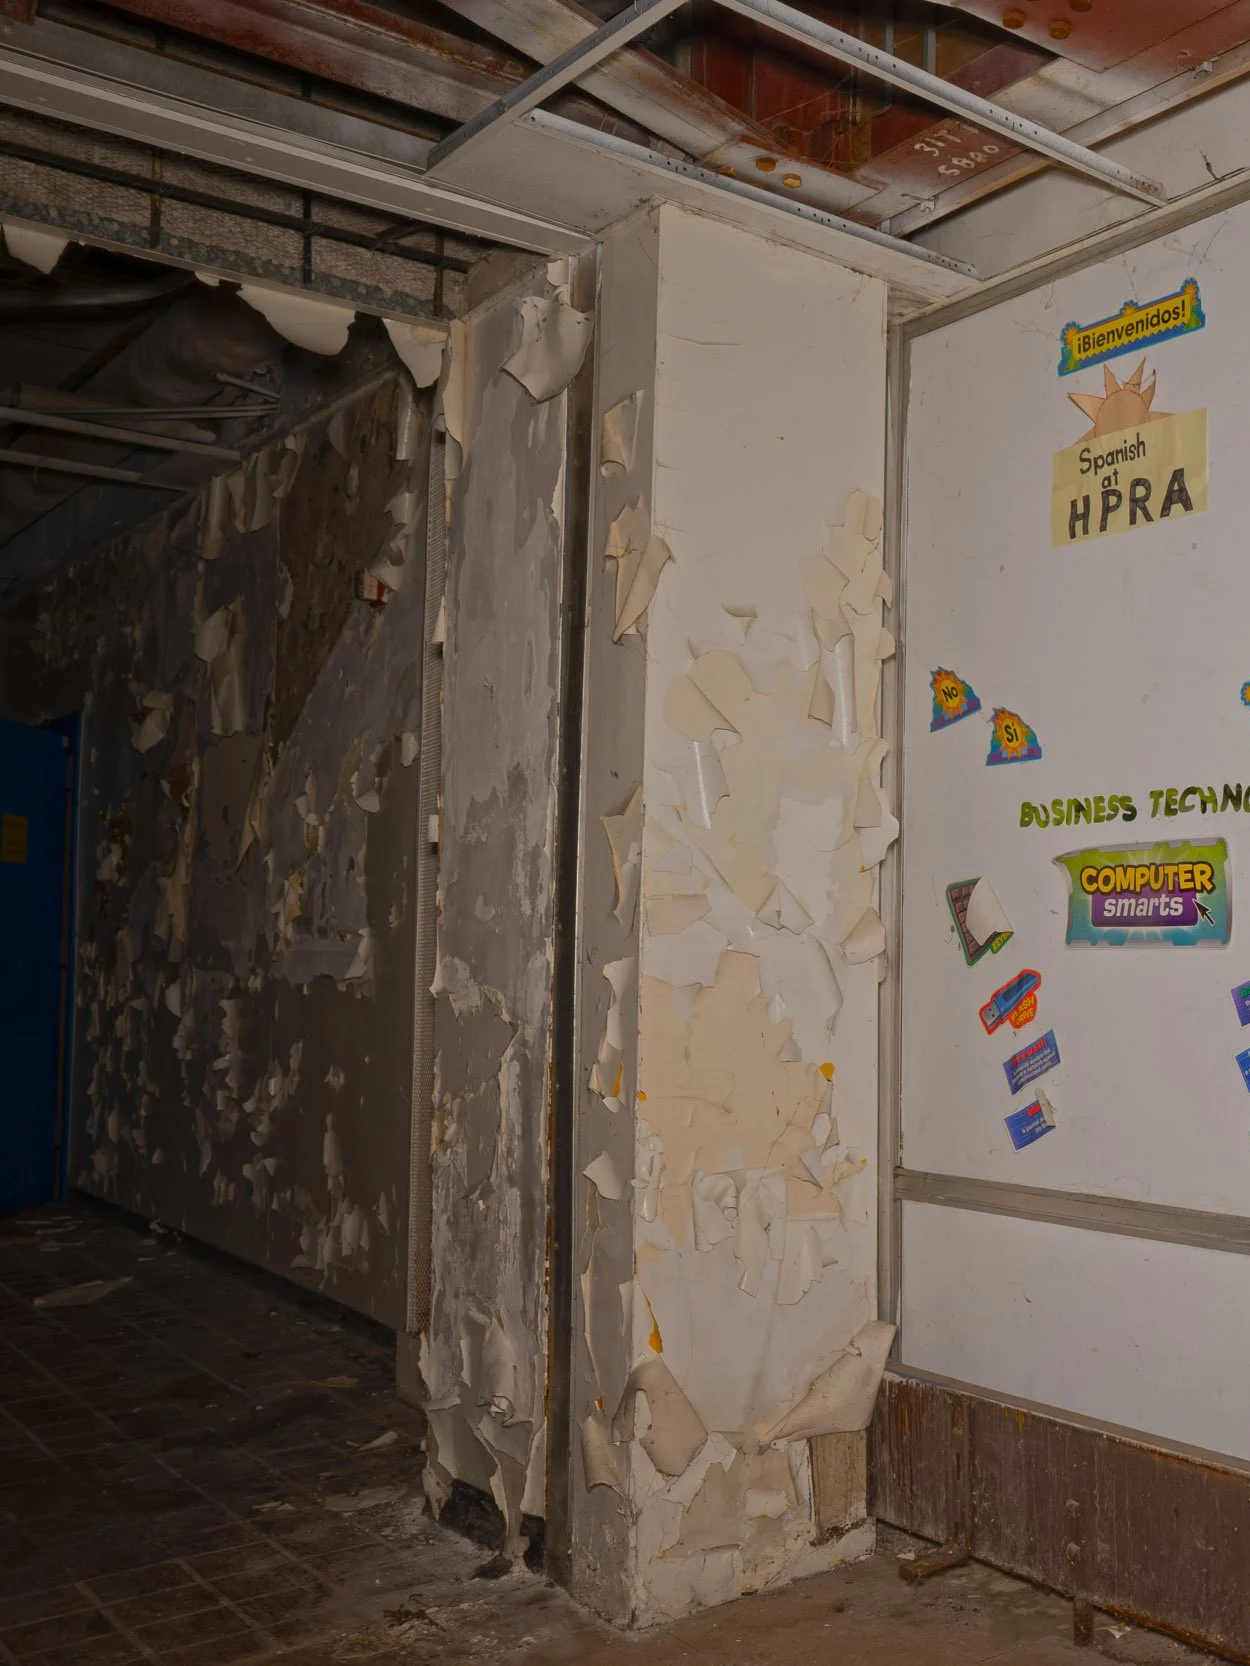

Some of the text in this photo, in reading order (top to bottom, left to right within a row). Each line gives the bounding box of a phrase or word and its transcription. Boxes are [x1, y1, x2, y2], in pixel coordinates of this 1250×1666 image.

[1077, 300, 1186, 355] ¡Bienvenidos!
[1079, 432, 1146, 475] Spanish
[1102, 468, 1118, 489] at
[1069, 468, 1193, 539] HPRA
[1019, 794, 1137, 828] BUSINESS
[1080, 861, 1215, 895] COMPUTER
[1103, 893, 1184, 917] smarts
